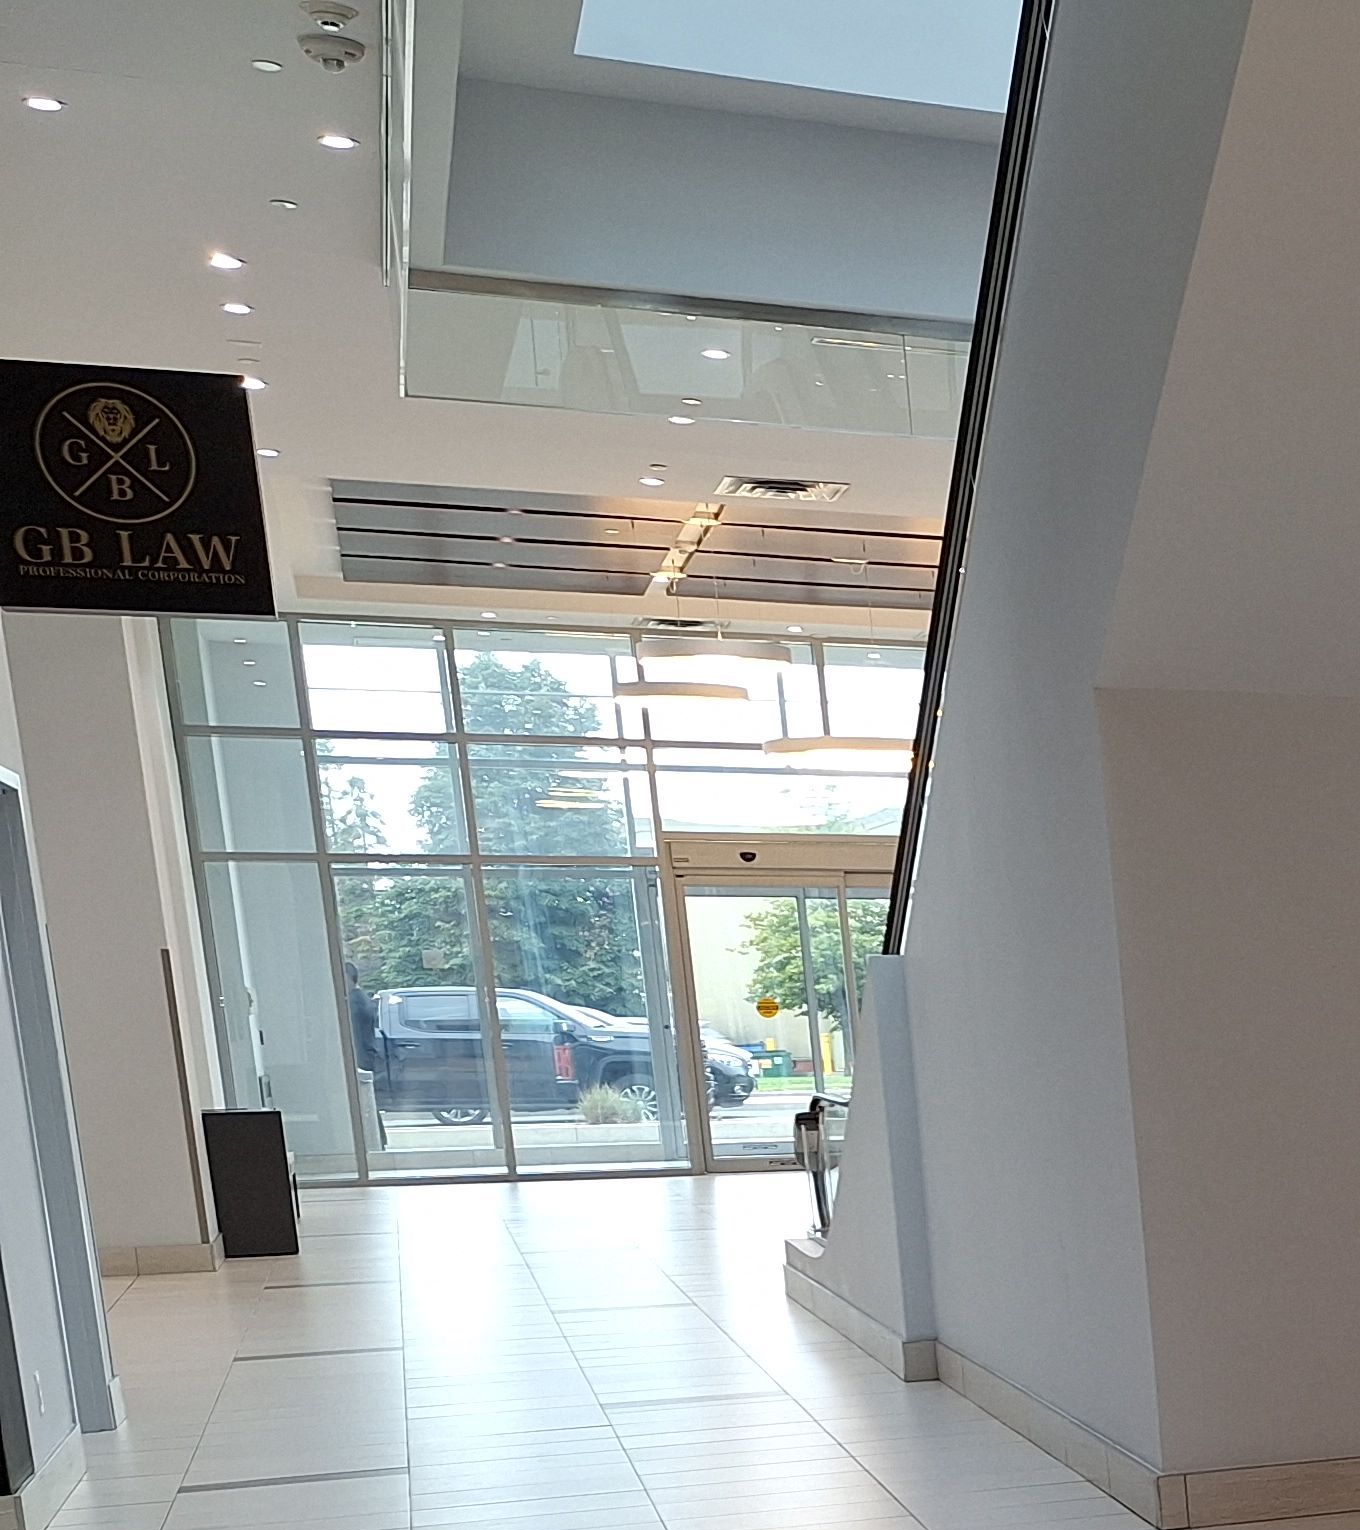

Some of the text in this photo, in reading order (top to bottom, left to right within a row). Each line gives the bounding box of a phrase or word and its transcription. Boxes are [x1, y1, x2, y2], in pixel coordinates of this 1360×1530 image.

[14, 525, 240, 571] GB LAW
[19, 564, 246, 585] PROFESSIONAL CORPORATION
